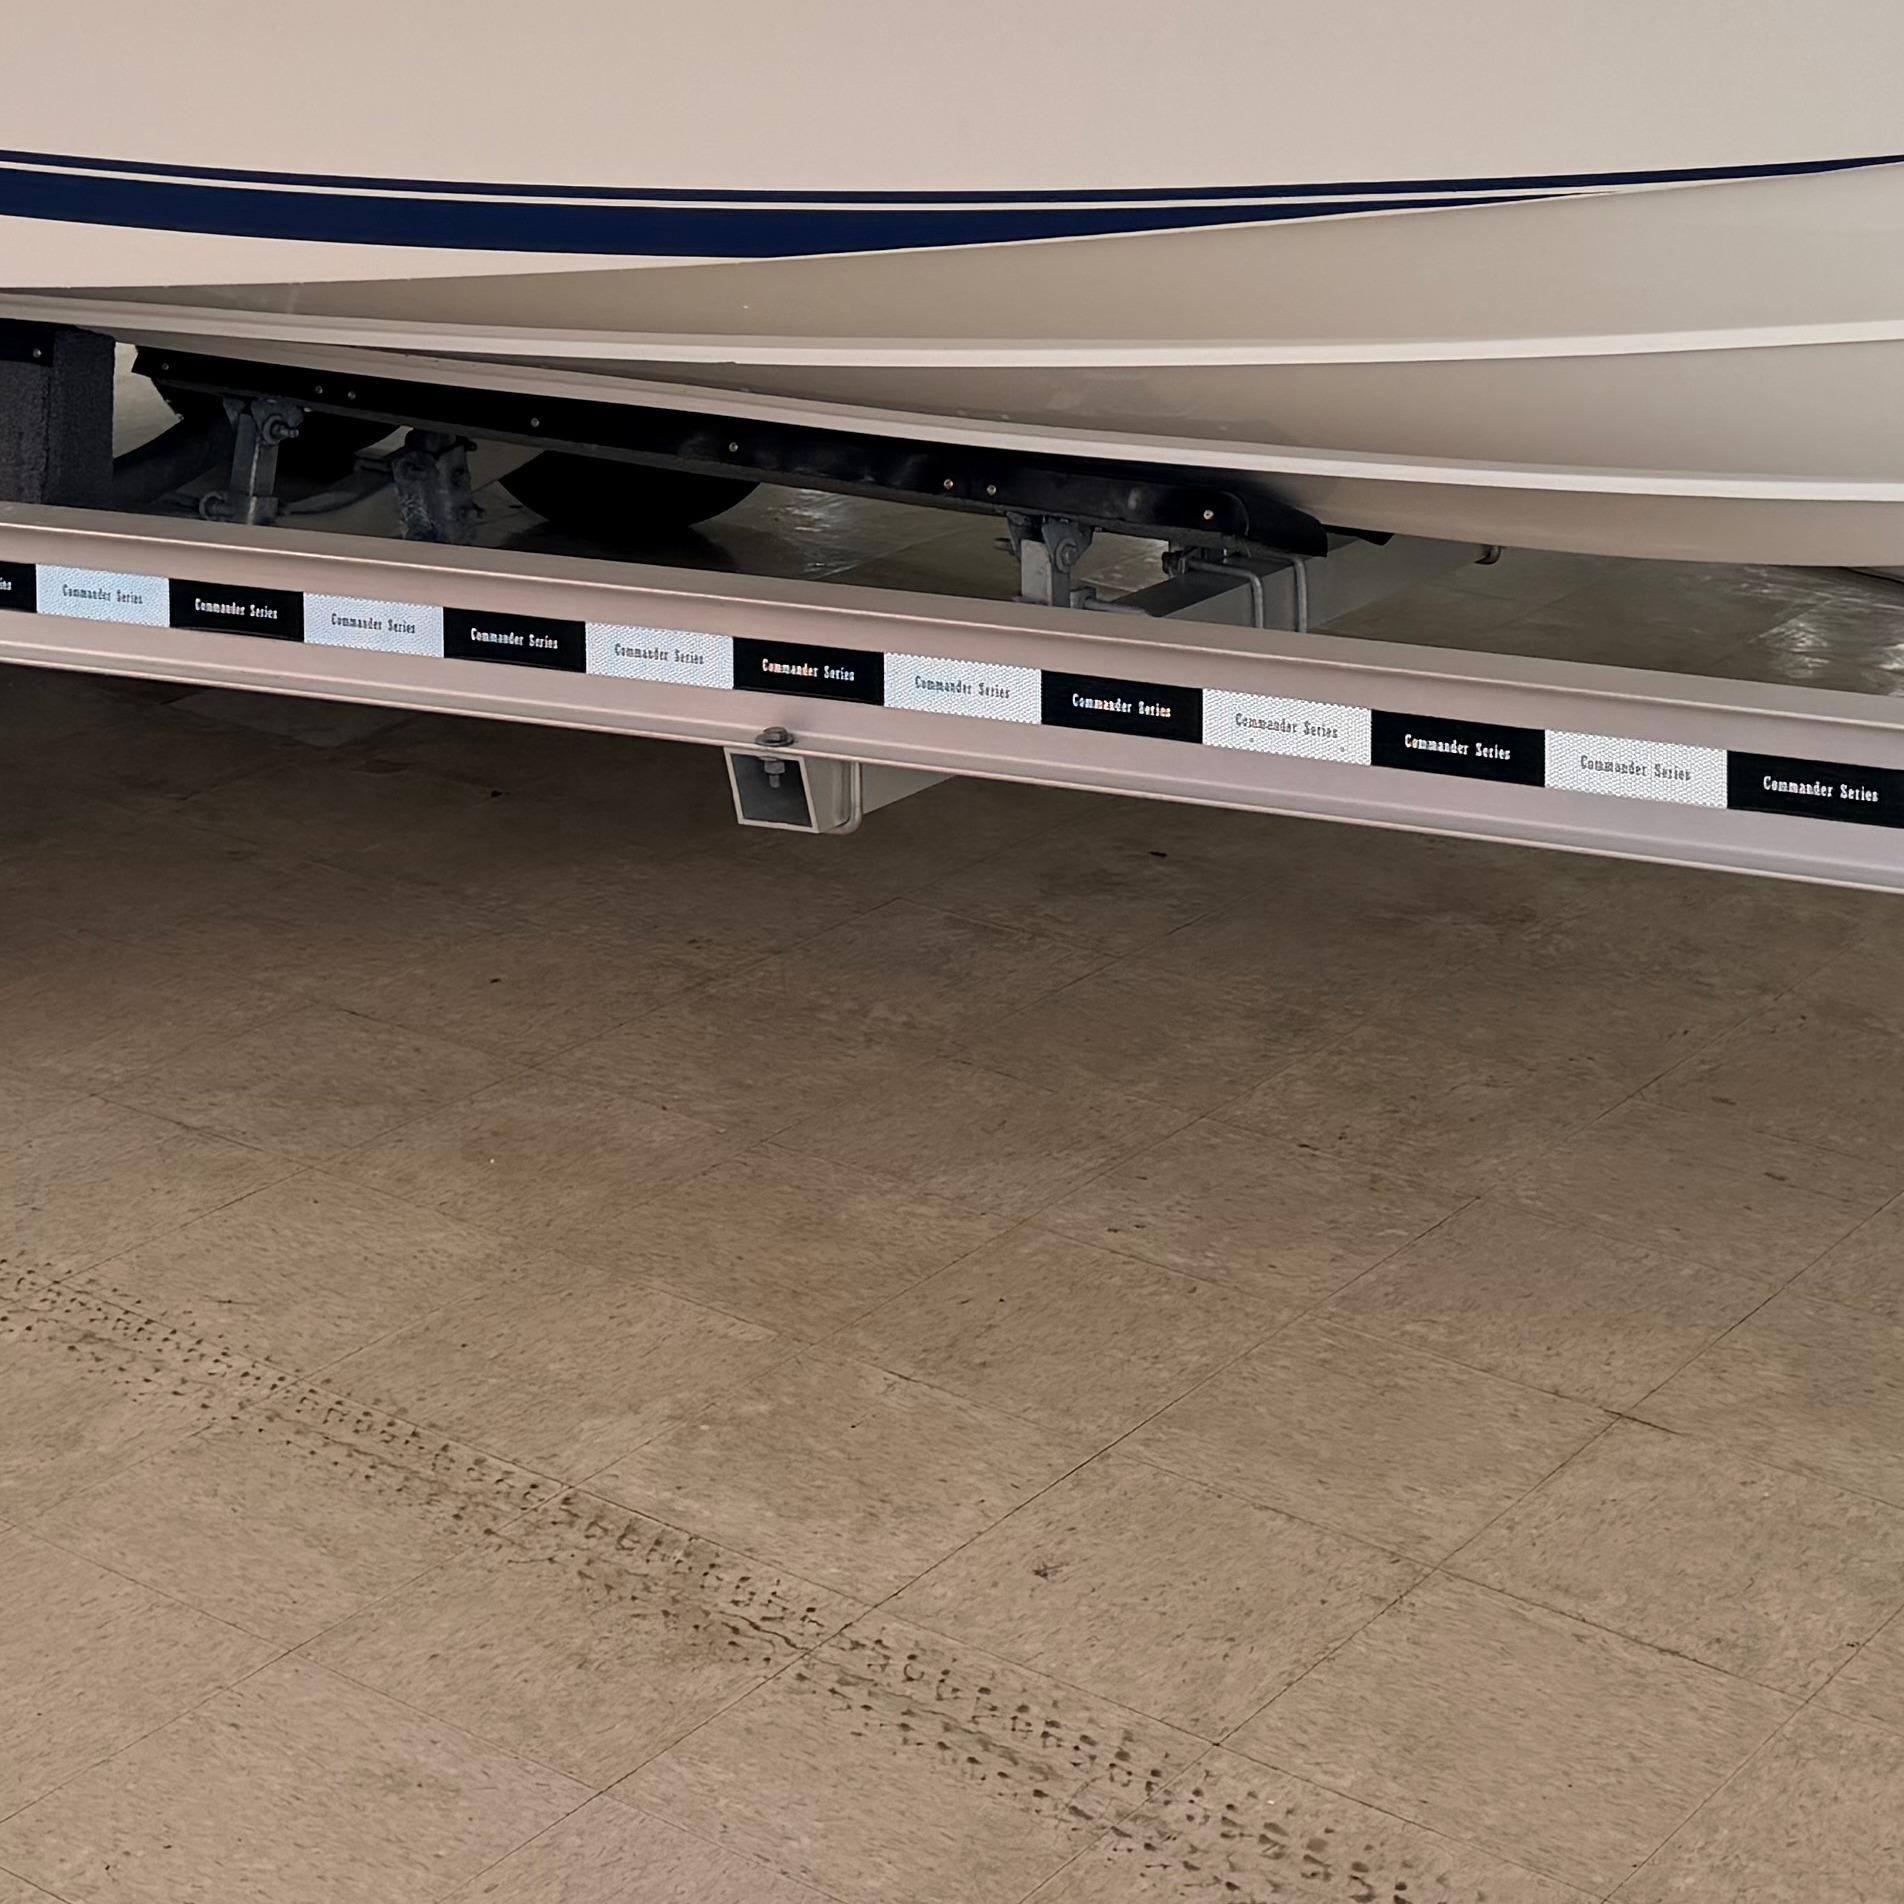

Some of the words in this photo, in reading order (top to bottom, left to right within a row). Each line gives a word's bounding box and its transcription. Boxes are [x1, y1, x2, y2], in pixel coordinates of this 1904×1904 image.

[62, 584, 111, 602] Commander
[195, 598, 245, 619] Commander
[249, 603, 278, 621] Series
[331, 612, 383, 632] Commander
[388, 616, 416, 634] Series
[470, 627, 524, 646] Commander
[529, 632, 558, 650] Series
[614, 642, 670, 663] Commander
[674, 647, 704, 665] Series
[761, 658, 819, 679] Commander
[823, 664, 855, 682] Series
[914, 674, 973, 696] Commander
[977, 680, 1010, 700] Series
[1072, 693, 1132, 717] Commander
[1138, 699, 1171, 719] Series
[1235, 712, 1297, 736] Commander
[1303, 720, 1338, 740] Series
[1403, 733, 1469, 757] Commander
[1475, 740, 1511, 761] Series
[1580, 755, 1647, 779] Commander
[1654, 762, 1691, 782] Series
[1763, 775, 1832, 800] Commander
[1840, 782, 1878, 804] Series
